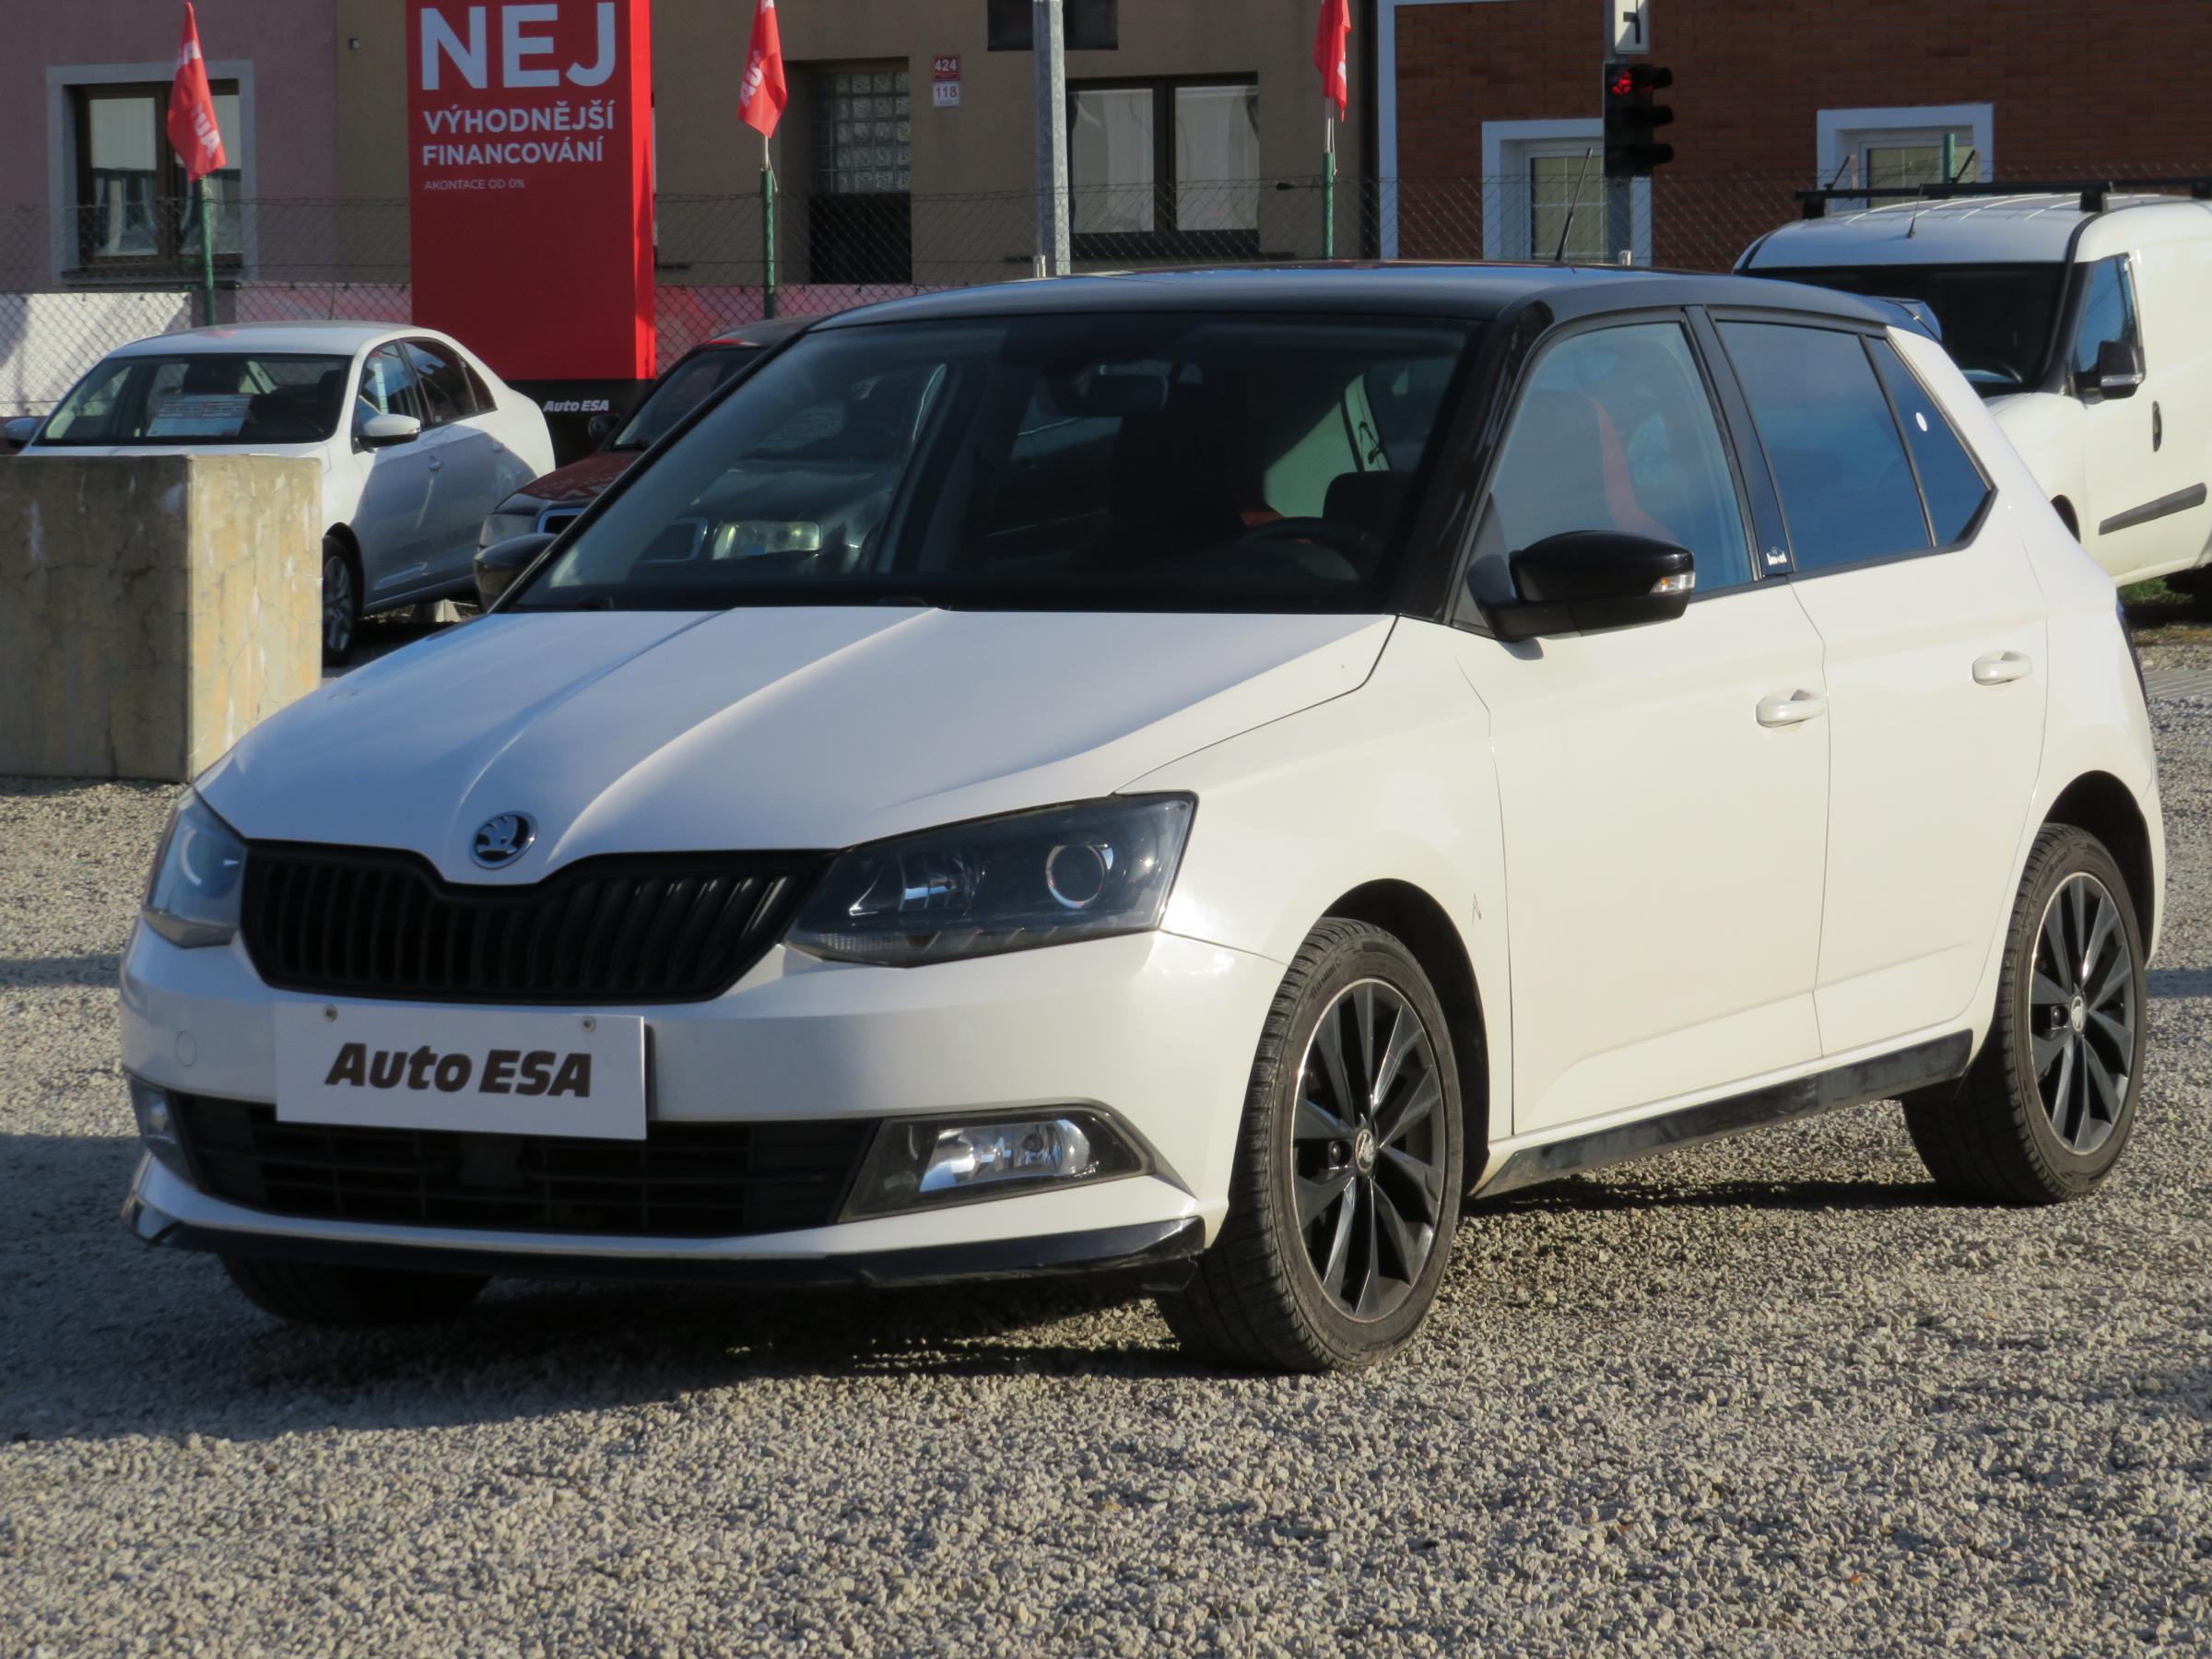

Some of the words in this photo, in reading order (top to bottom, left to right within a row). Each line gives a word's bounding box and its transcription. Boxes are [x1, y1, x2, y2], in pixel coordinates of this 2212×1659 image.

[420, 2, 616, 90] NEJ
[935, 59, 957, 72] 424
[936, 86, 957, 98] 118
[424, 100, 615, 135] VÝHODNĚJŠÍ
[423, 135, 604, 165] FINANCOVÁNÍ
[425, 179, 485, 190] AKONTACE
[488, 179, 506, 189] OD
[509, 178, 525, 189] 0%
[543, 400, 580, 412] Auto
[581, 399, 609, 412] ESA
[324, 1042, 473, 1092] Auto
[478, 1049, 593, 1098] ESA
